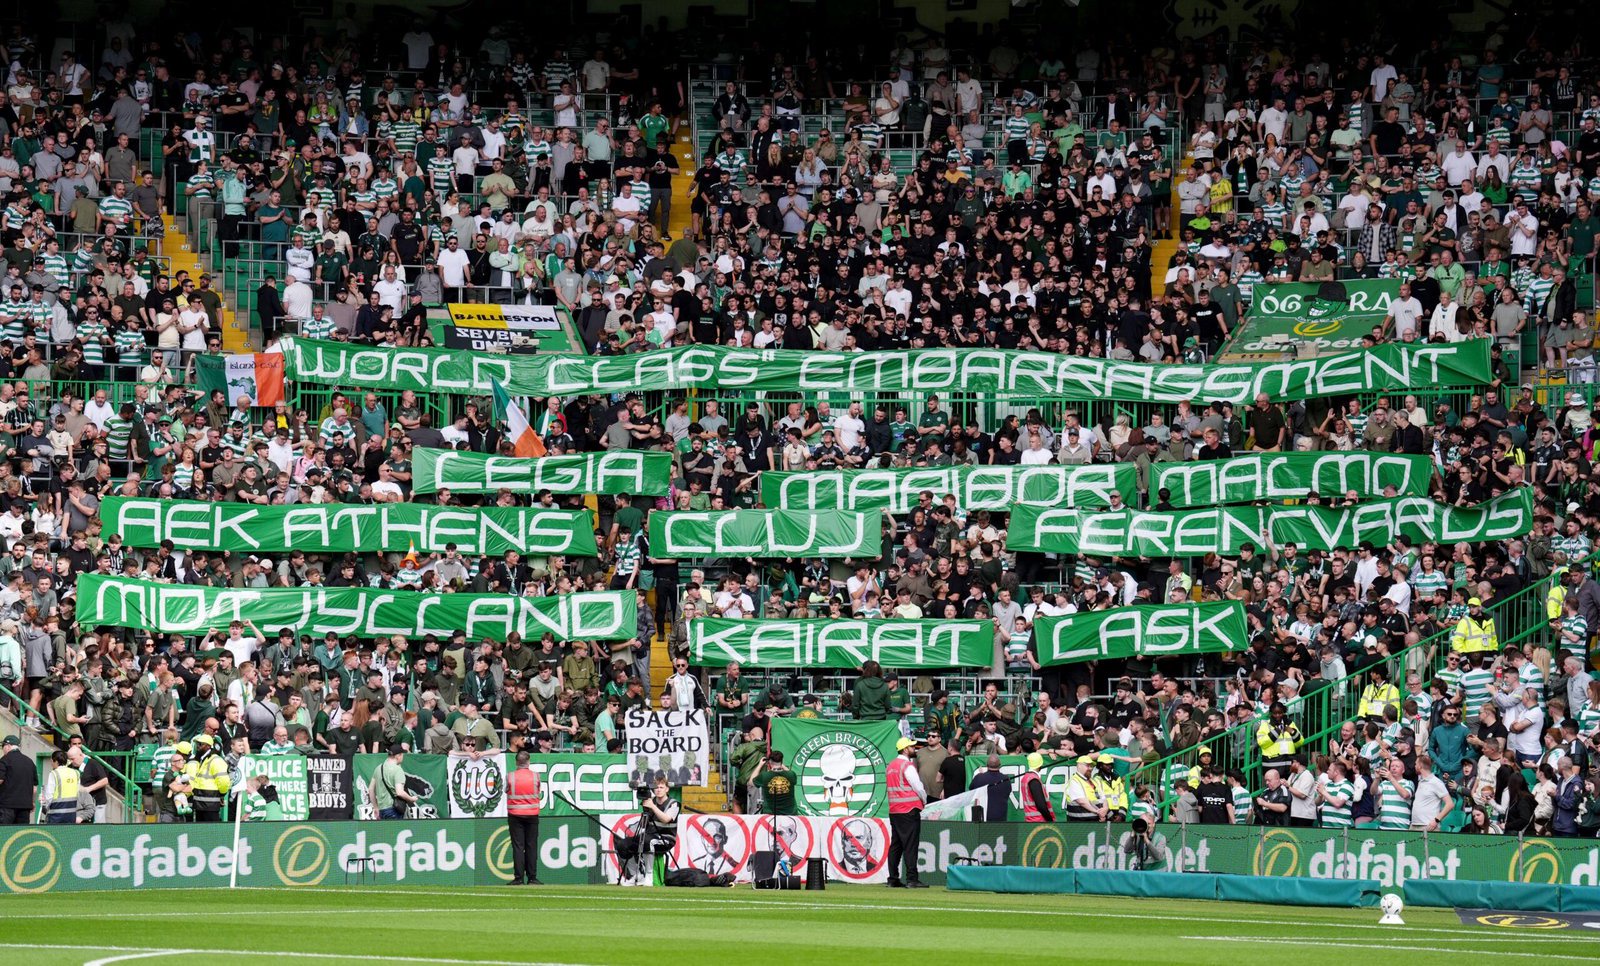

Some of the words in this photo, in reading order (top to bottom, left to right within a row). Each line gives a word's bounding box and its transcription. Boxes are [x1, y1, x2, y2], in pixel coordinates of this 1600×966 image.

[799, 347, 1457, 400] EMBARRASSMENT
[435, 452, 643, 492] LEGIA
[780, 465, 1116, 512] MARIBOR
[1158, 454, 1411, 504] MALMO
[118, 502, 260, 549] AEK
[284, 507, 573, 552] ATHENS
[665, 512, 864, 554] CLUJ
[1034, 490, 1524, 552] FERENCVAROS
[696, 622, 981, 665] KAIRAT
[1053, 604, 1235, 660] LASK
[628, 709, 701, 729] SACK
[655, 729, 675, 738] THE
[307, 758, 346, 771] BANNED
[629, 736, 701, 754] BOARD
[794, 734, 831, 767] GREEN
[834, 732, 884, 767] BRIGADE
[245, 757, 303, 778] POLICE
[527, 763, 643, 811] GREE
[309, 793, 347, 808] BHOYS
[70, 832, 252, 887] dafabet
